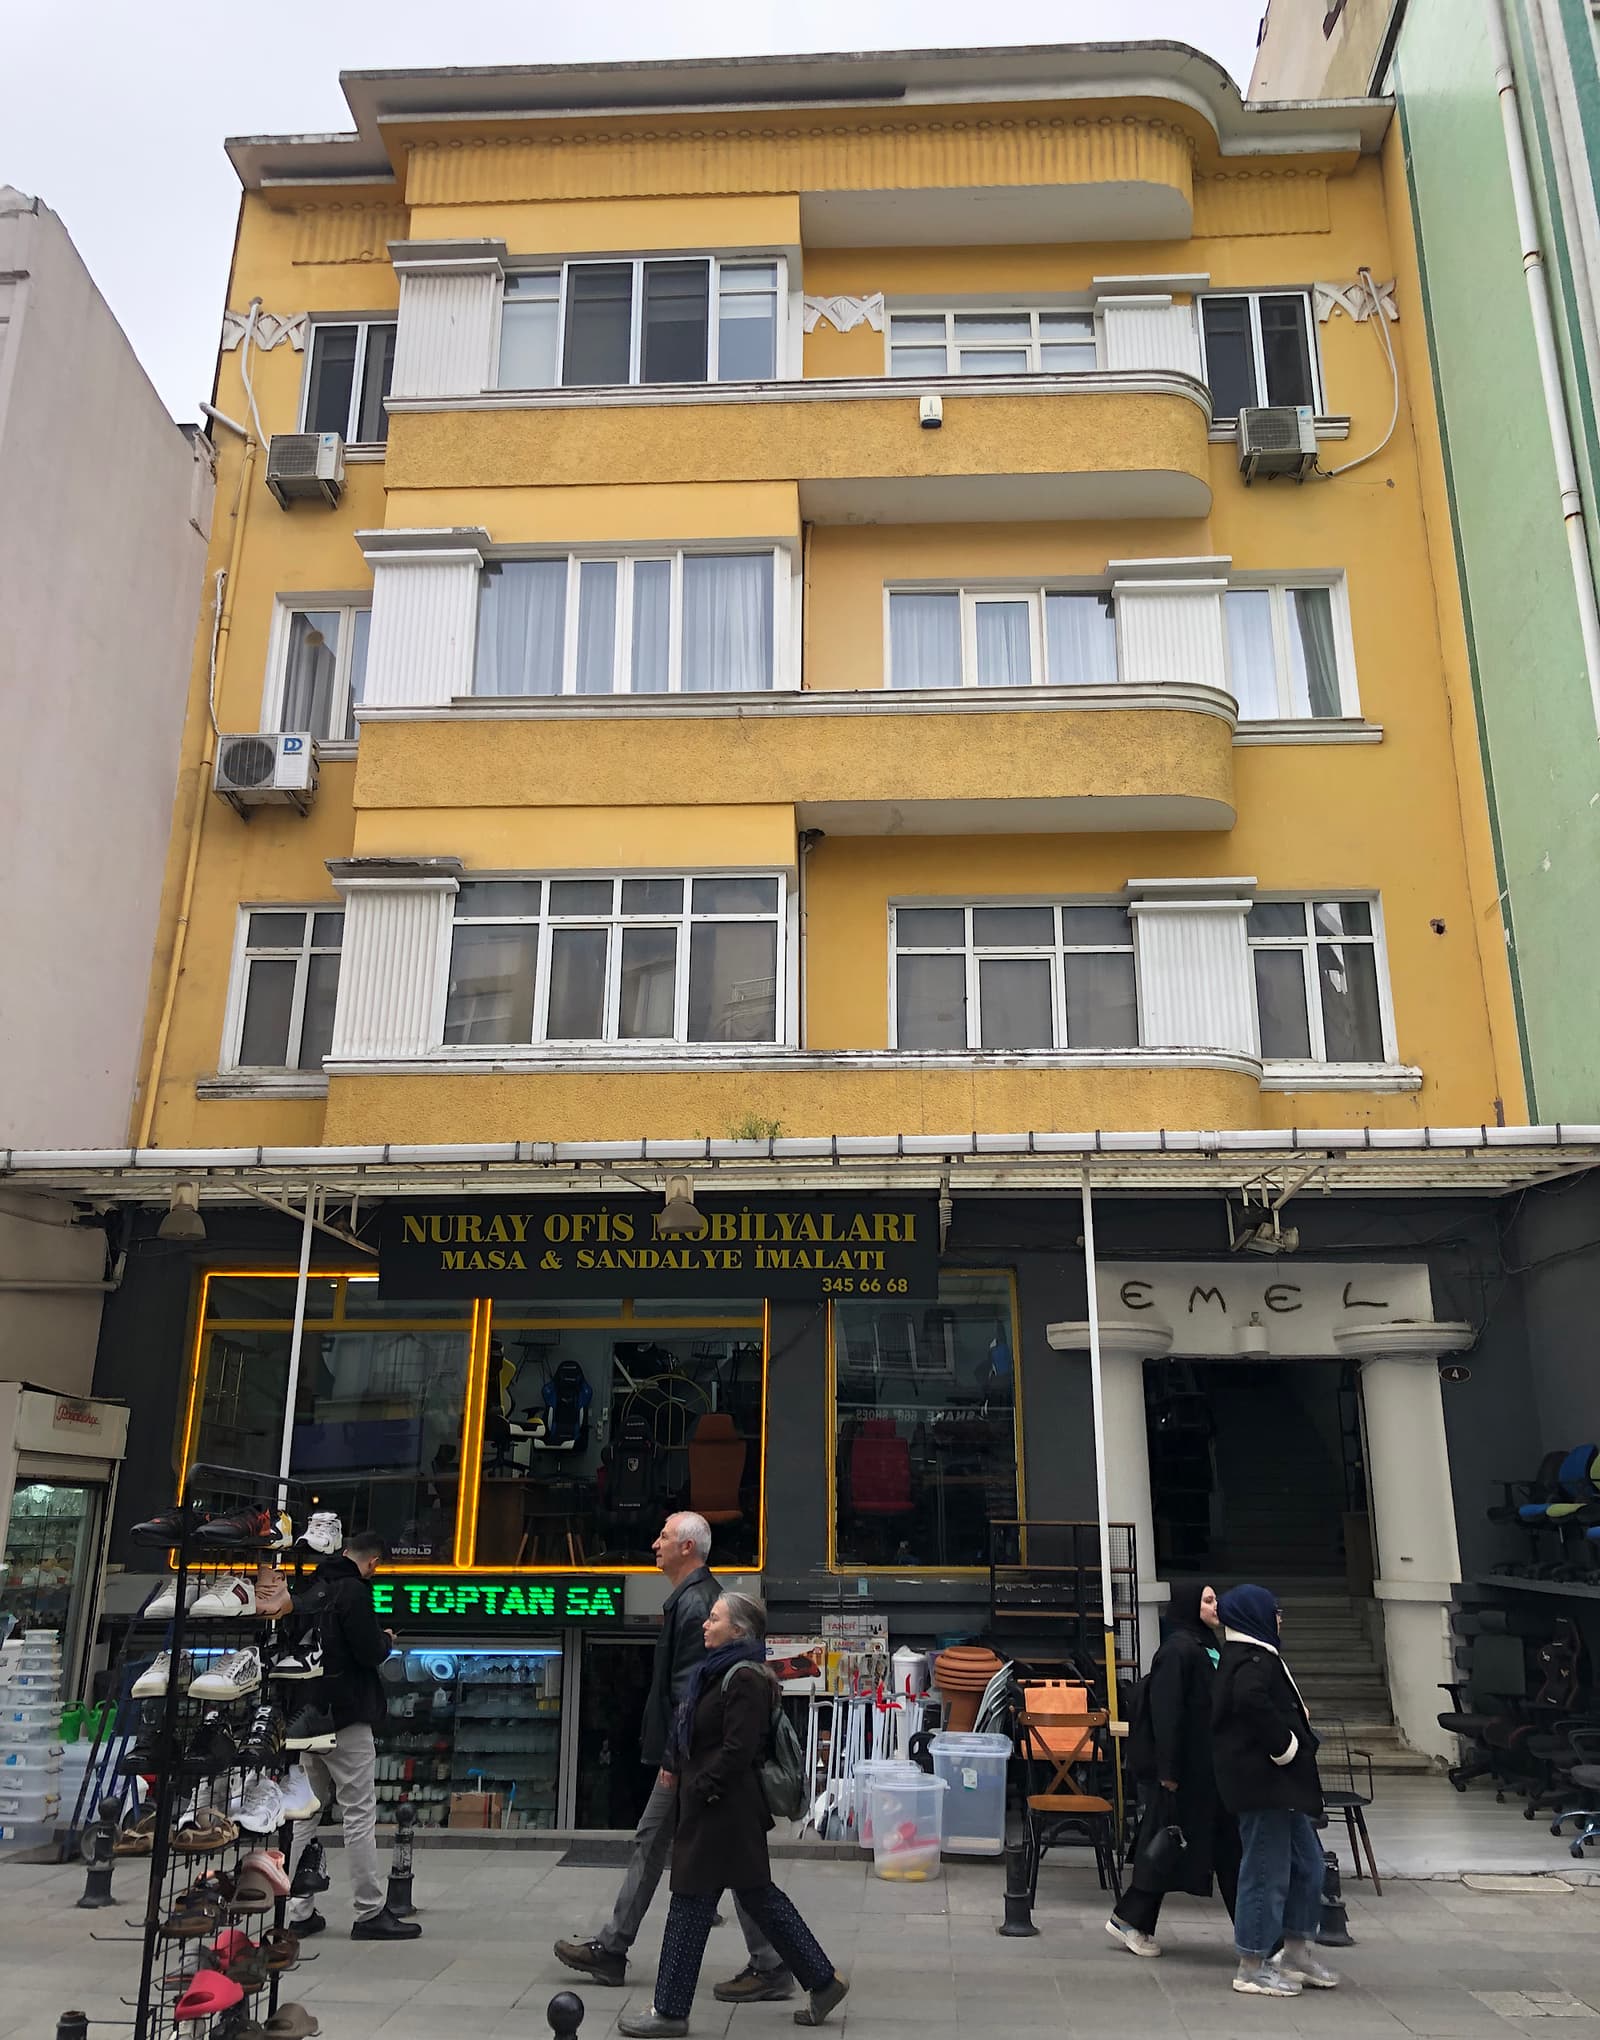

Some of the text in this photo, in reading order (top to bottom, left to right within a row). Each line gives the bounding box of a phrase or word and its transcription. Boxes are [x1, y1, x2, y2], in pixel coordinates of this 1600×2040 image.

[402, 1213, 534, 1243] NURAY
[543, 1206, 634, 1242] OFİS
[440, 1244, 886, 1270] MASA & SANDALYE İMALATI
[822, 1278, 908, 1292] 345 66 68
[1120, 1281, 1389, 1313] EMEL
[1451, 1368, 1460, 1380] 4
[391, 1547, 432, 1555] WORLD
[403, 1585, 556, 1615] TOPTAN
[566, 1587, 622, 1616] SA
